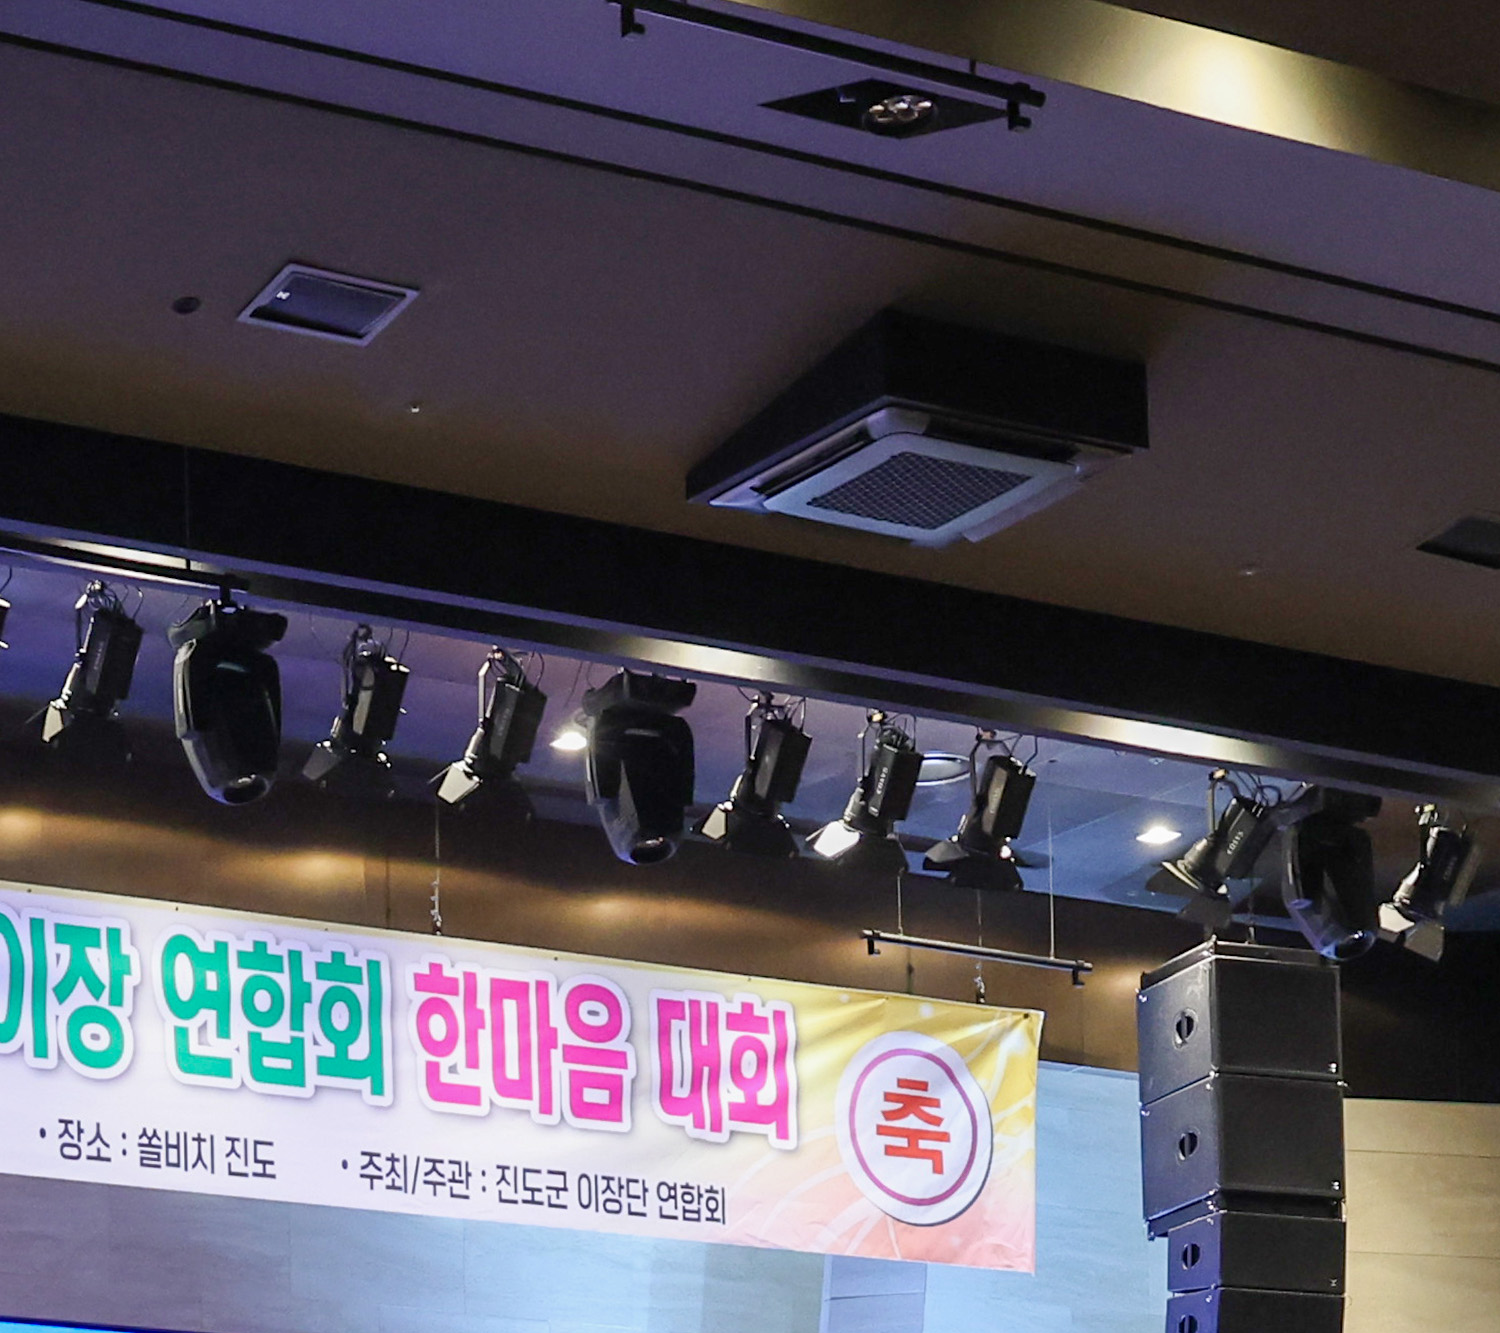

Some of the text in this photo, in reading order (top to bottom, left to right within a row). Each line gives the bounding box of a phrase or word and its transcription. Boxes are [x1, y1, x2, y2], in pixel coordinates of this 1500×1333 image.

[163, 933, 385, 1096] 연합회
[412, 963, 630, 1122] 한마음
[657, 997, 790, 1140] 대회
[56, 1118, 112, 1160] 장소
[139, 1128, 215, 1177] 쏠비치
[225, 1135, 277, 1181] 진도
[876, 1077, 950, 1175] 축
[359, 1150, 473, 1198] 주최/주관
[496, 1165, 569, 1209] 진도군
[577, 1171, 649, 1218] 이장단
[656, 1180, 727, 1226] 연합회
